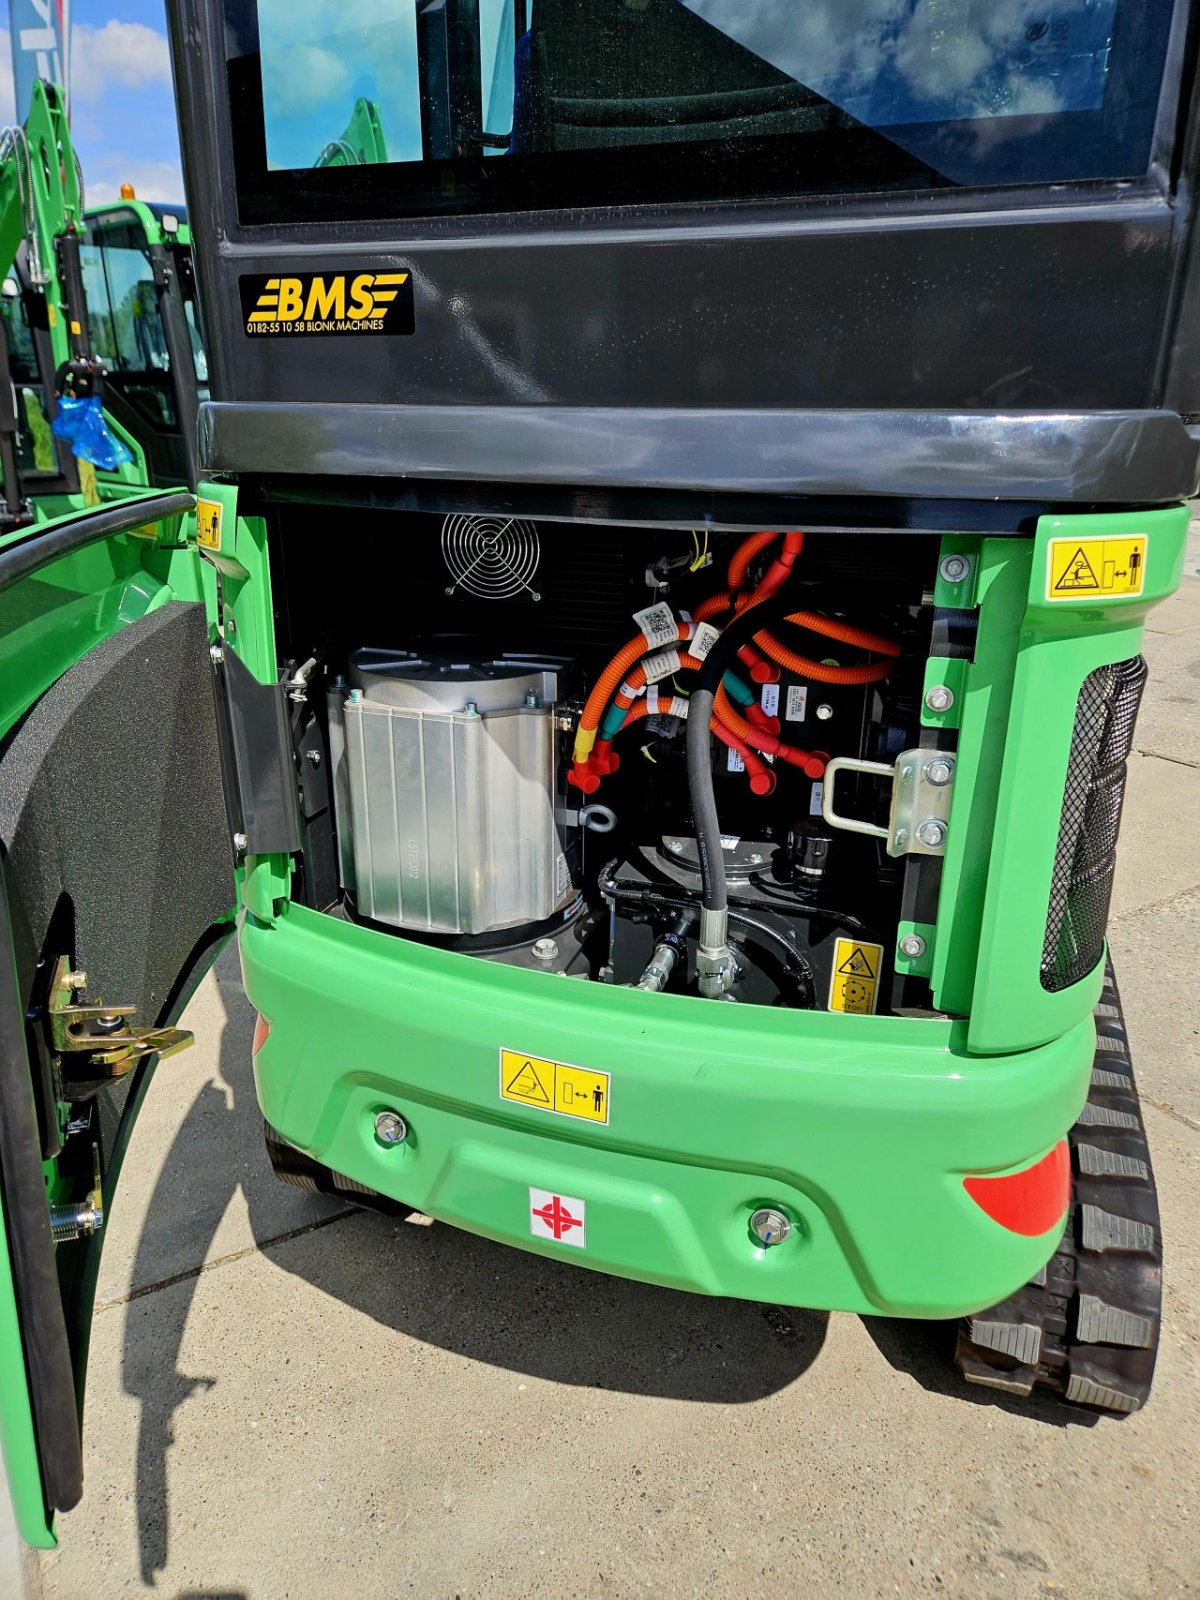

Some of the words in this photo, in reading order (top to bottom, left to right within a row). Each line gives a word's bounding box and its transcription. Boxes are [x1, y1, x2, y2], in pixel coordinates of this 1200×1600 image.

[277, 273, 375, 321] BMS
[247, 322, 280, 333] 0182-55
[282, 322, 292, 332] 10
[294, 321, 305, 332] 58
[307, 321, 338, 332] BLONK
[337, 319, 384, 331] MACHINES
